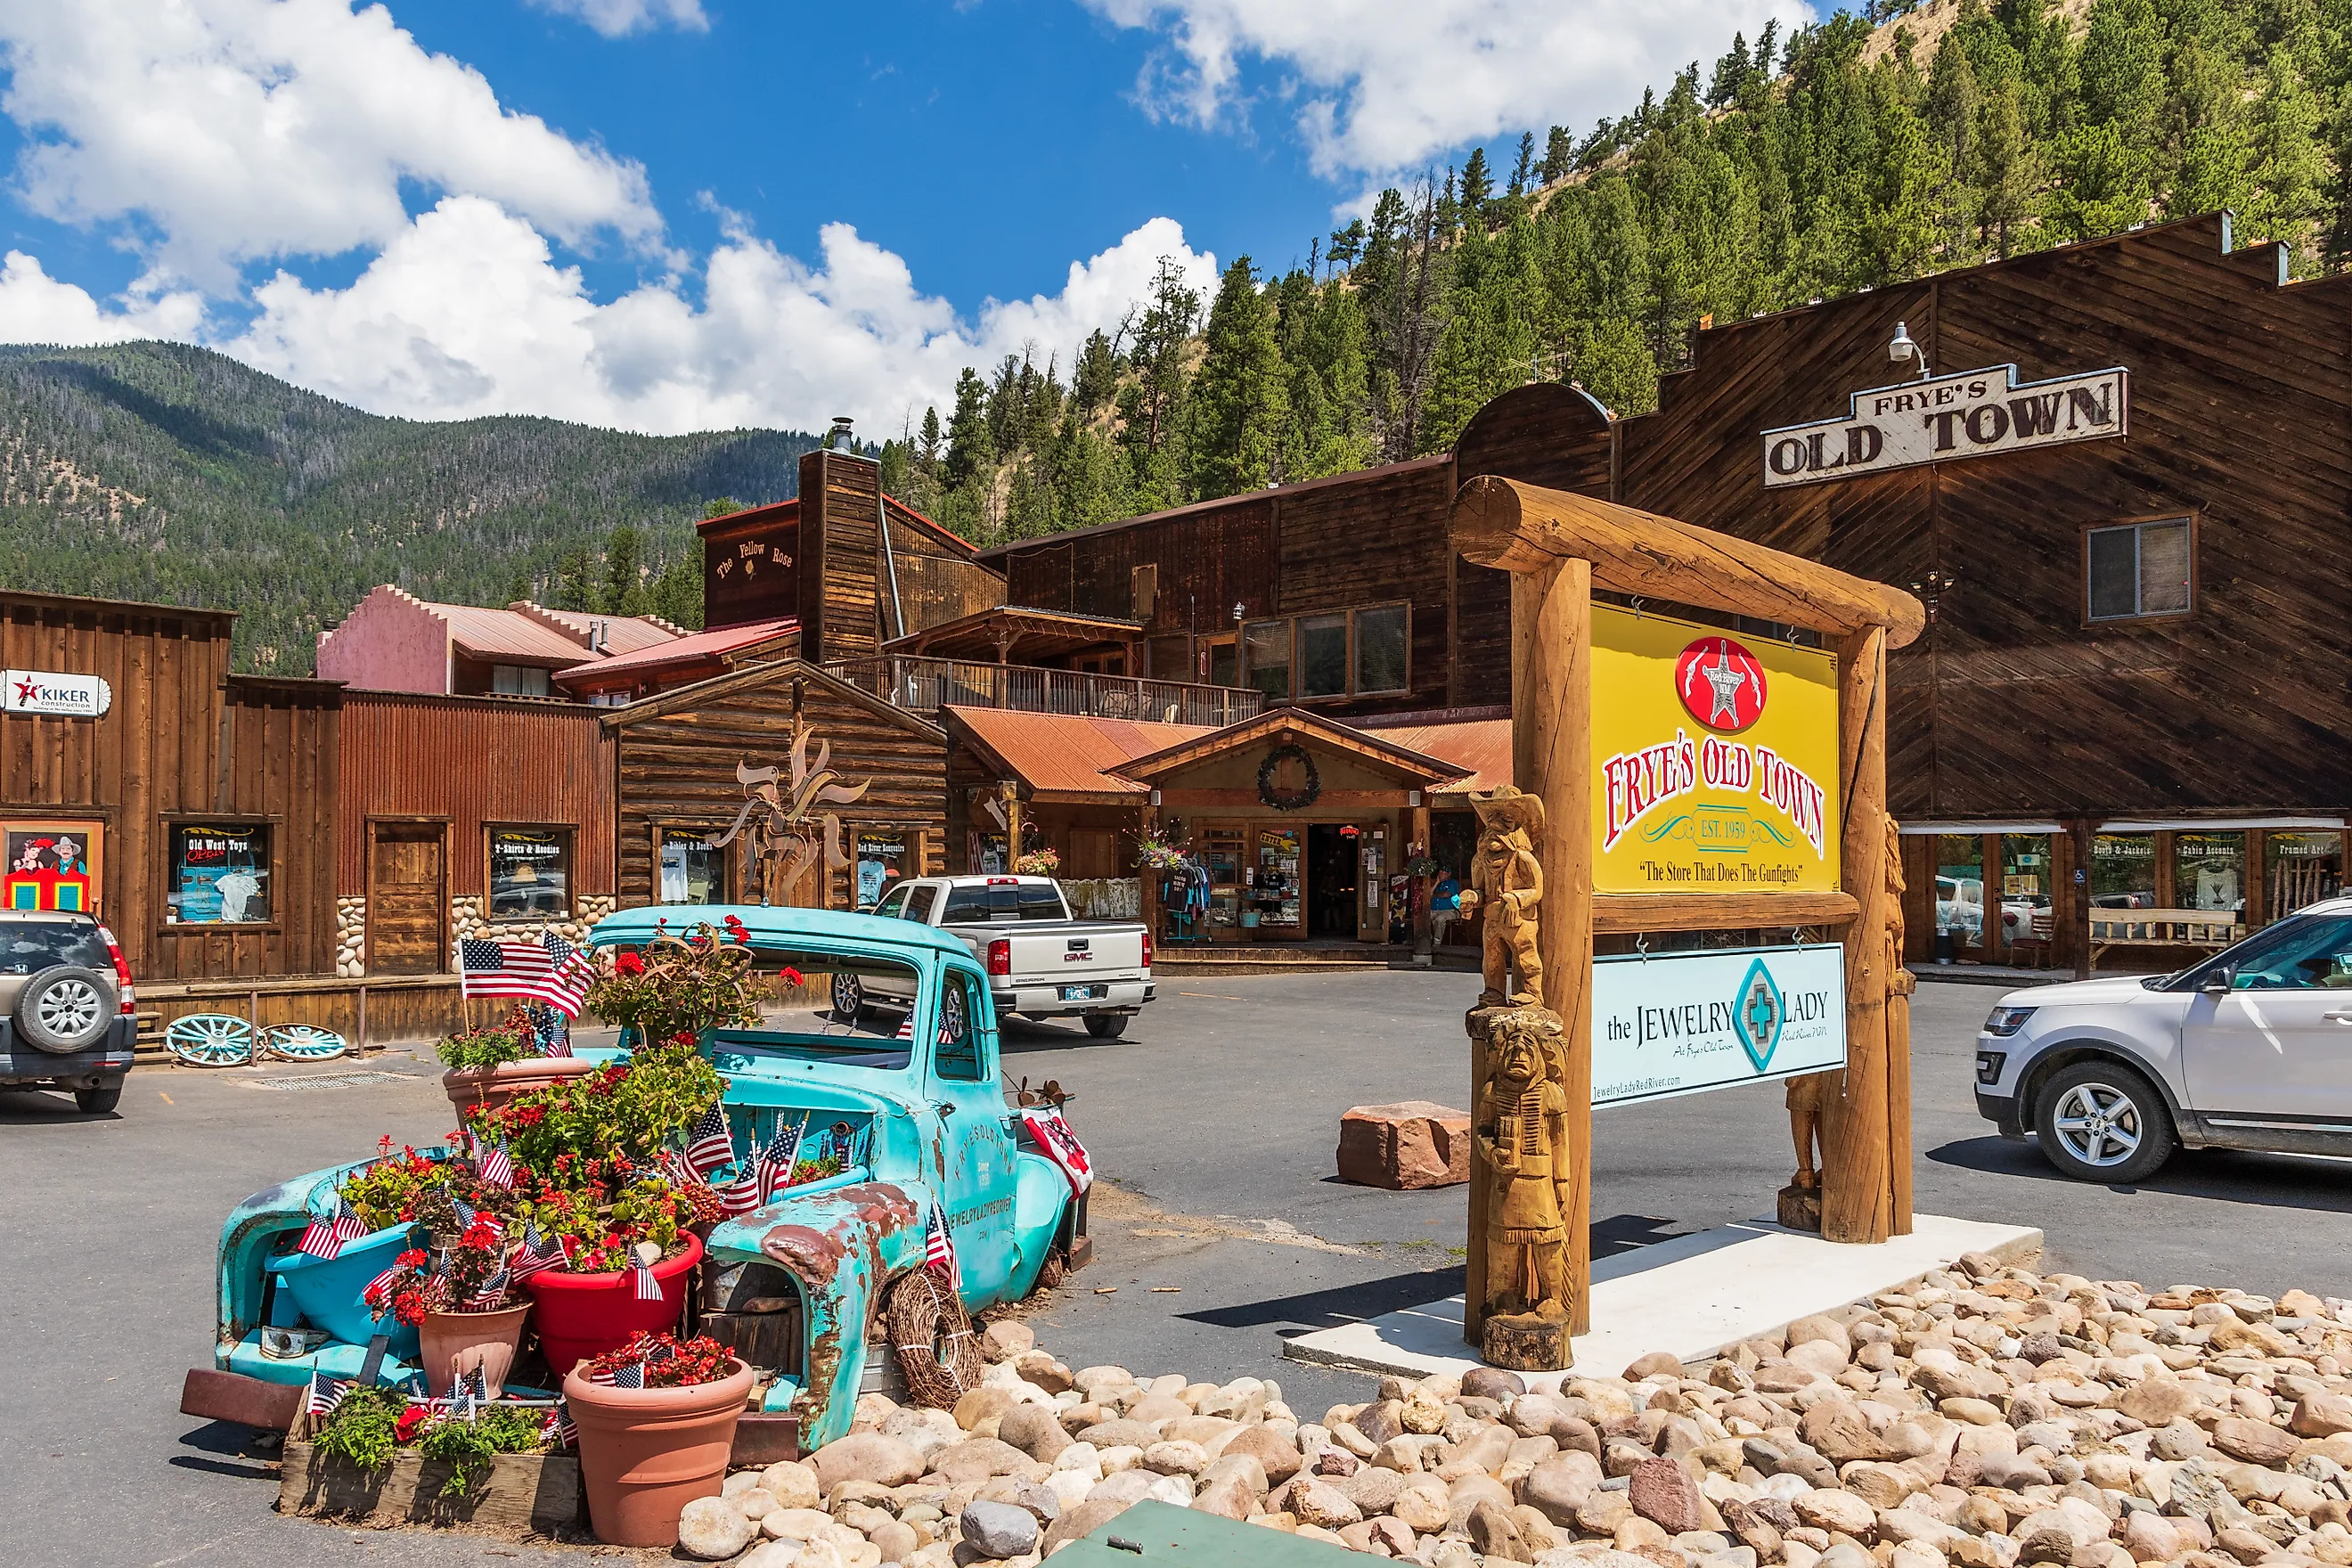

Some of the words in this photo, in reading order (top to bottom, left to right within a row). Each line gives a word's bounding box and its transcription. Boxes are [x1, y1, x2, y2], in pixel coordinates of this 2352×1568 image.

[1874, 380, 1987, 417] FRYE'S
[1768, 424, 1883, 476] OLD
[1923, 381, 2112, 453] TOWN
[716, 558, 733, 579] The
[739, 540, 765, 559] Yellow
[772, 547, 793, 568] Rose
[1710, 670, 1722, 682] Red
[1722, 673, 1740, 685] River
[42, 688, 90, 703] KIKER
[1719, 683, 1731, 695] NM
[40, 700, 91, 708] construction
[1604, 731, 1695, 849] FRYE'S
[1702, 738, 1751, 788] OLD
[1756, 747, 1824, 857] TOWN
[1701, 820, 1722, 838] EST.
[1724, 821, 1746, 839] 1959
[188, 839, 203, 851] Old
[205, 839, 226, 851] West
[228, 839, 248, 853] Toys
[669, 840, 687, 850] Bibles
[689, 841, 695, 851] &
[696, 841, 713, 851] Books
[1261, 832, 1282, 846] ENTER
[494, 844, 525, 853] T-Shirts
[526, 845, 533, 853] &
[868, 843, 882, 853] River
[2093, 845, 2112, 854] Boots
[2114, 845, 2121, 854] &
[2123, 845, 2151, 855] Jackets
[2183, 845, 2203, 855] Cabin
[2206, 845, 2234, 855] Accents
[2279, 845, 2308, 854] Framed
[2310, 845, 2324, 854] Art
[1666, 861, 1692, 882] Store
[1694, 862, 1715, 882] That
[1717, 862, 1739, 883] Does
[1740, 862, 1757, 883] The
[1064, 951, 1093, 962] GMC
[1607, 1015, 1631, 1041] the
[1636, 1000, 1735, 1049] JEWELRY
[1782, 991, 1828, 1024] LADY
[1781, 1030, 1795, 1041] Red
[1812, 1025, 1827, 1038] NM
[1672, 1045, 1686, 1058] At
[1703, 1041, 1718, 1053] Old
[1718, 1039, 1734, 1051] Town
[1593, 1076, 1681, 1100] JewelryLadyRedRiver.com
[954, 1123, 980, 1180] FRYE'S
[980, 1123, 995, 1143] OLD
[995, 1132, 1012, 1178] TOWN
